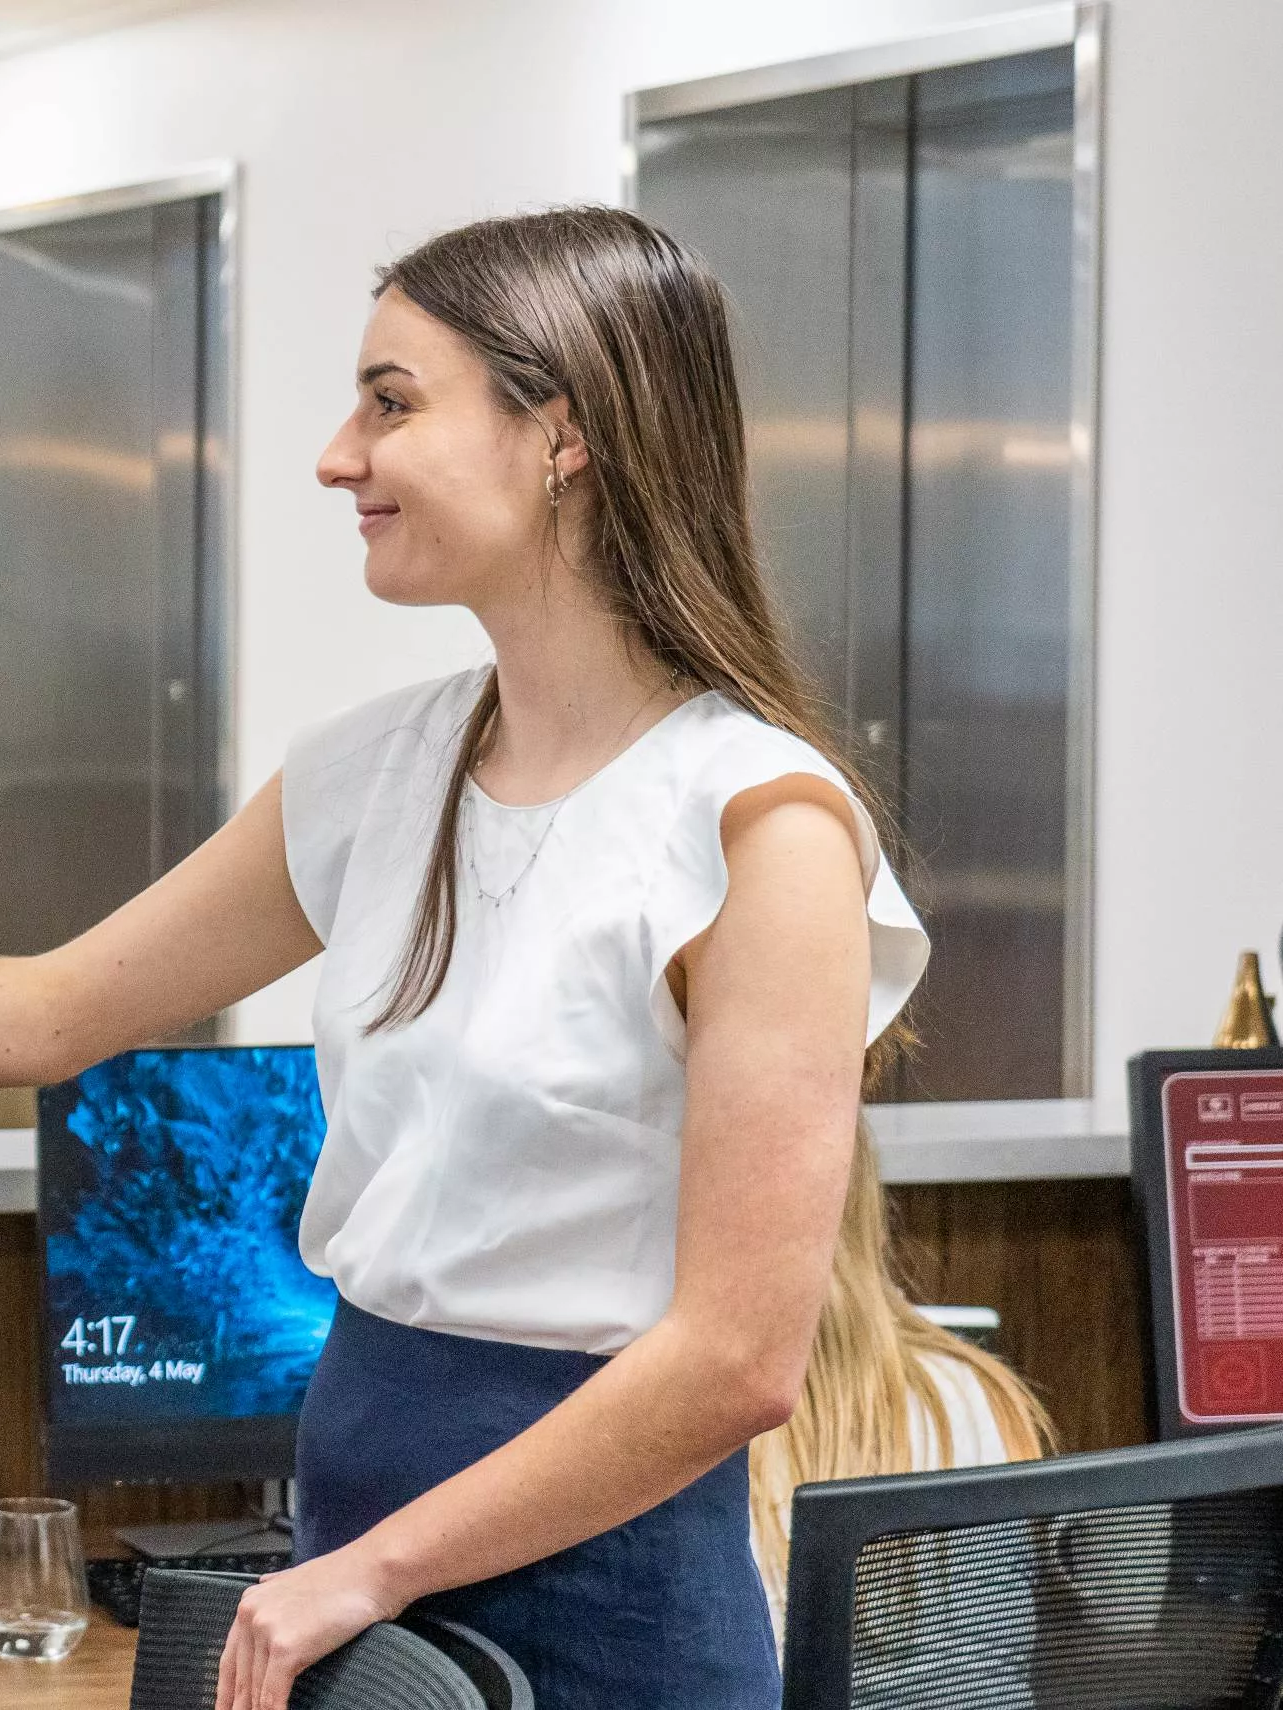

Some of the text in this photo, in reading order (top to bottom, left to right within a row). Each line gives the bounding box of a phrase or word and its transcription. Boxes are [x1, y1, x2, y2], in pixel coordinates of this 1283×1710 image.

[60, 1315, 137, 1357] 4:17
[61, 1360, 207, 1386] Thursday, 4 May
